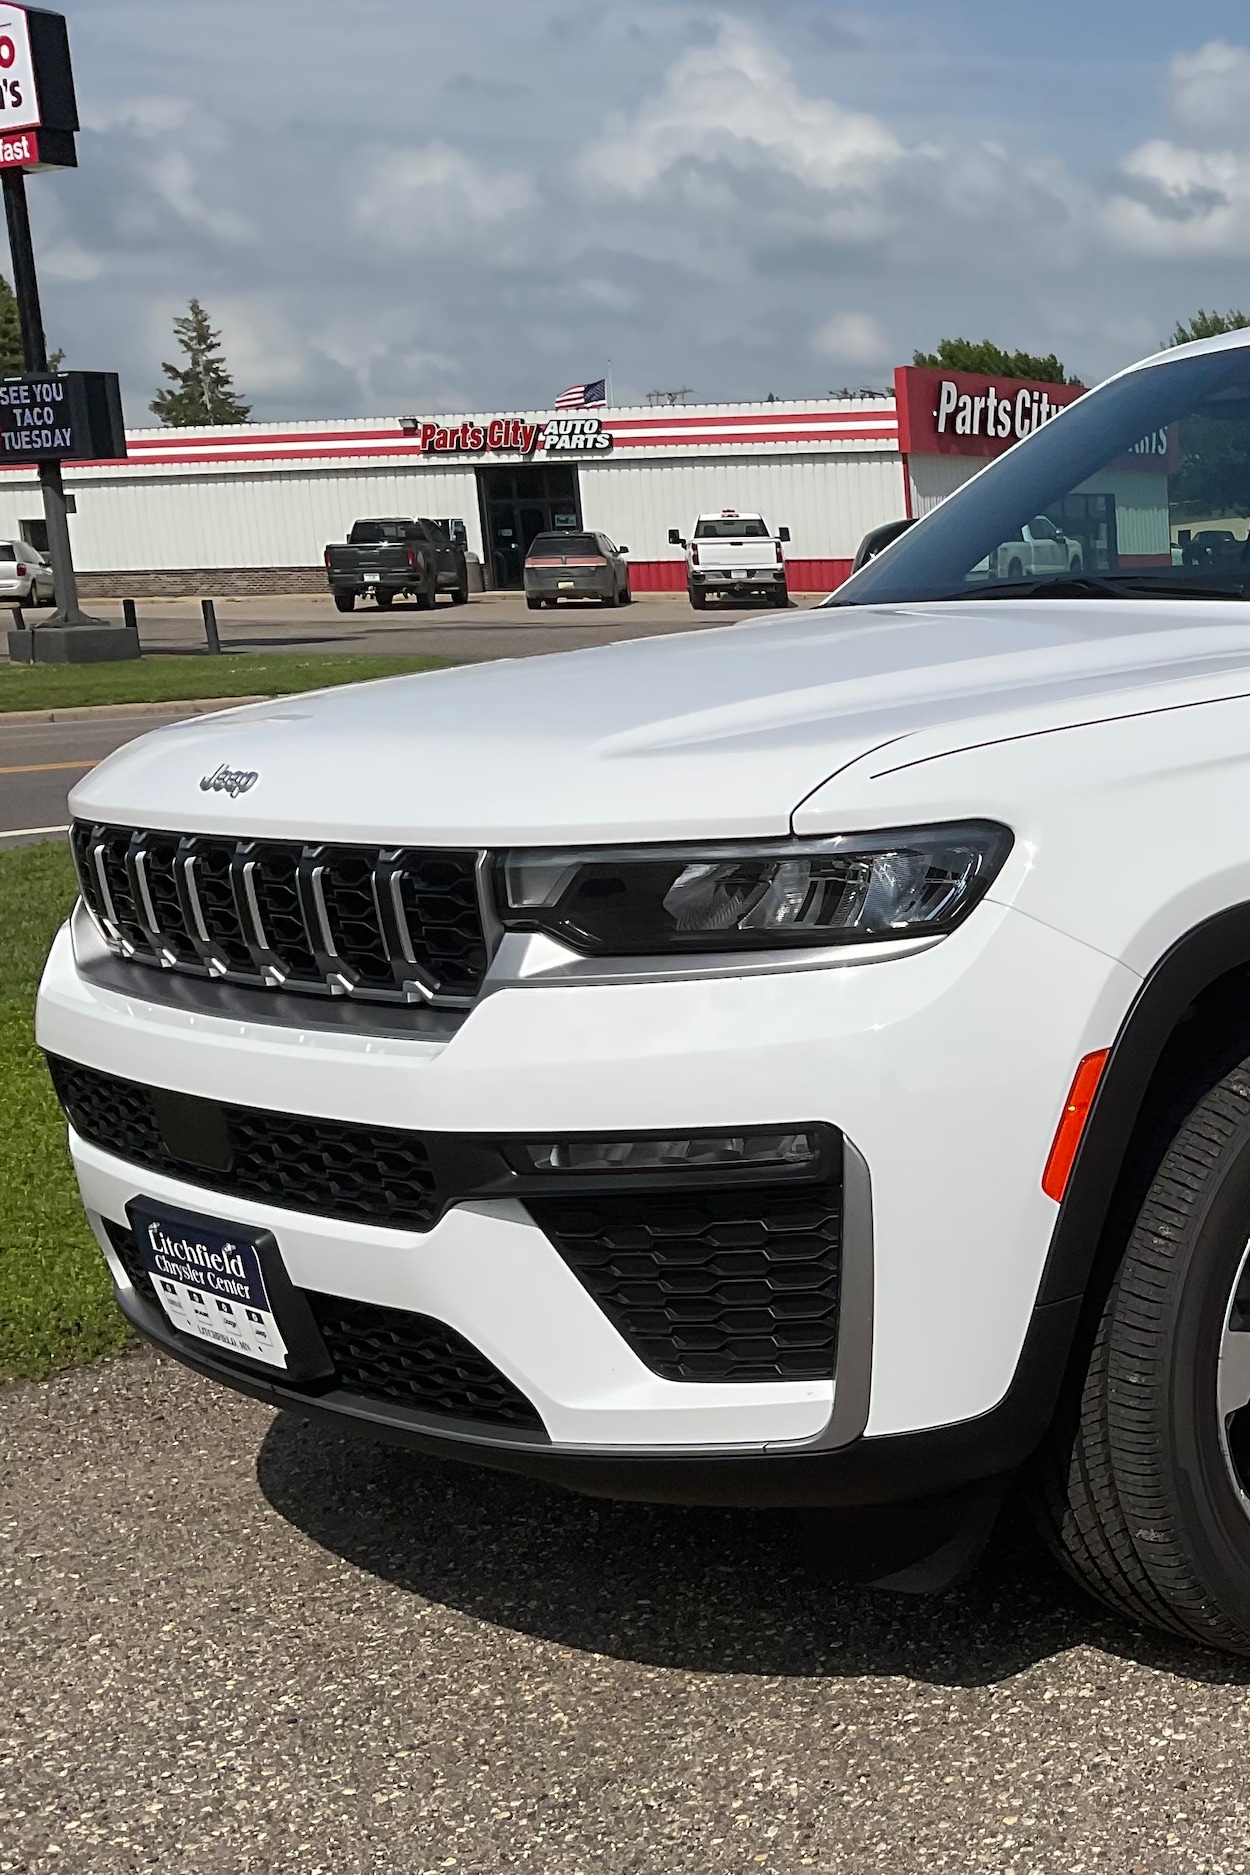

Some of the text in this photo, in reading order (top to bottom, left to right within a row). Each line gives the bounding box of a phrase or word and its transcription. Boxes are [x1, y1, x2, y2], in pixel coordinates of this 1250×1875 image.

[0, 383, 63, 405] SEE YOU
[13, 407, 54, 426] TACO
[938, 381, 1064, 439] Parts Cit
[1, 428, 71, 450] TUESDAY
[420, 418, 539, 454] Parts City
[544, 420, 599, 434] AUTO
[544, 433, 610, 449] PARTS
[199, 763, 258, 798] Jeep
[148, 1228, 246, 1278] Litchfield
[155, 1254, 251, 1300] Chrysler Center
